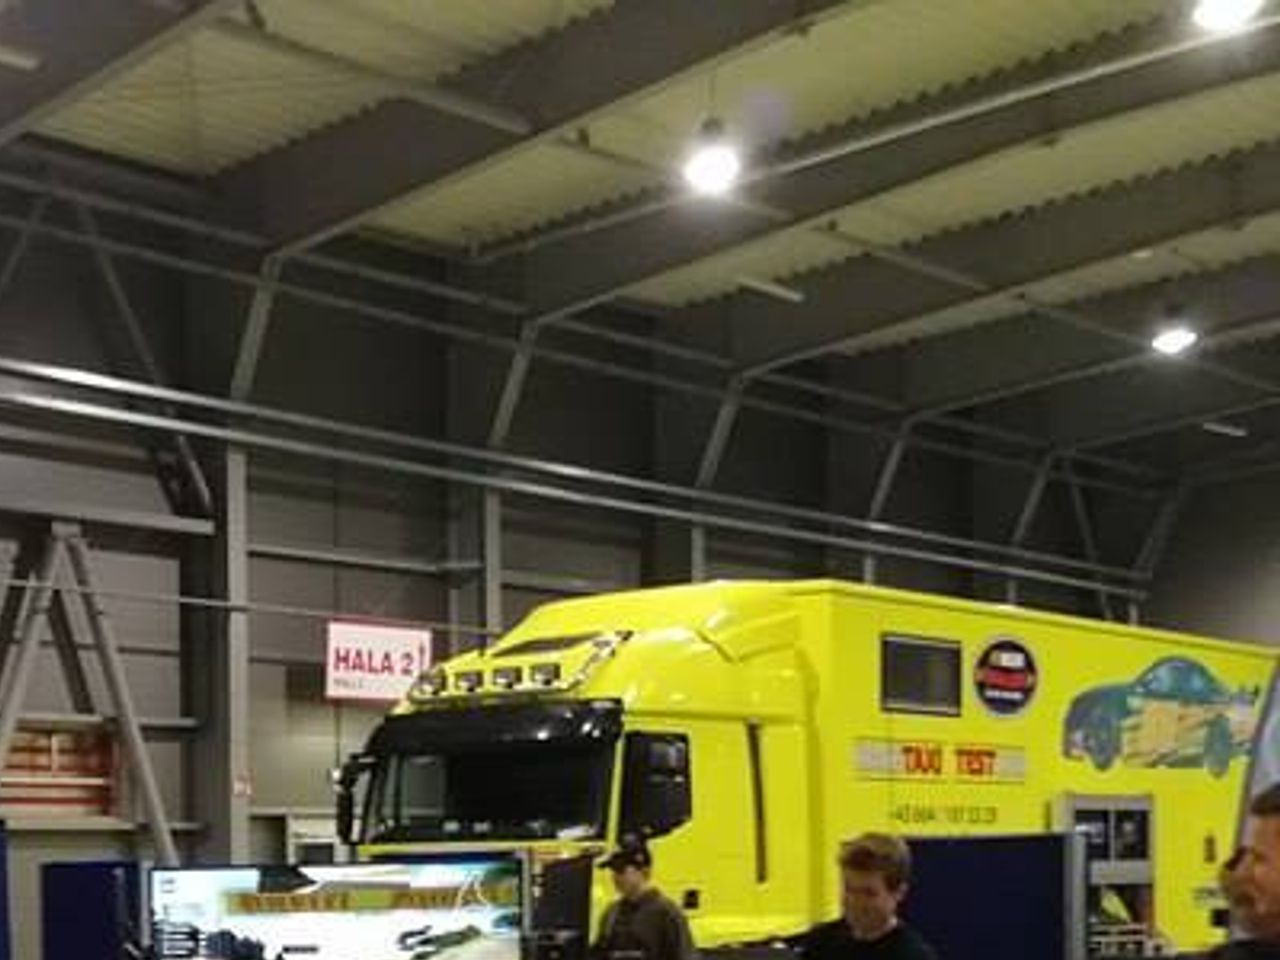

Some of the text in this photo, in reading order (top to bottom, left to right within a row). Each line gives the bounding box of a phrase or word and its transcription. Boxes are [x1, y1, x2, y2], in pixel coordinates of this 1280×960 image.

[334, 646, 414, 677] HALA 2
[902, 745, 997, 777] TAXI TEST
